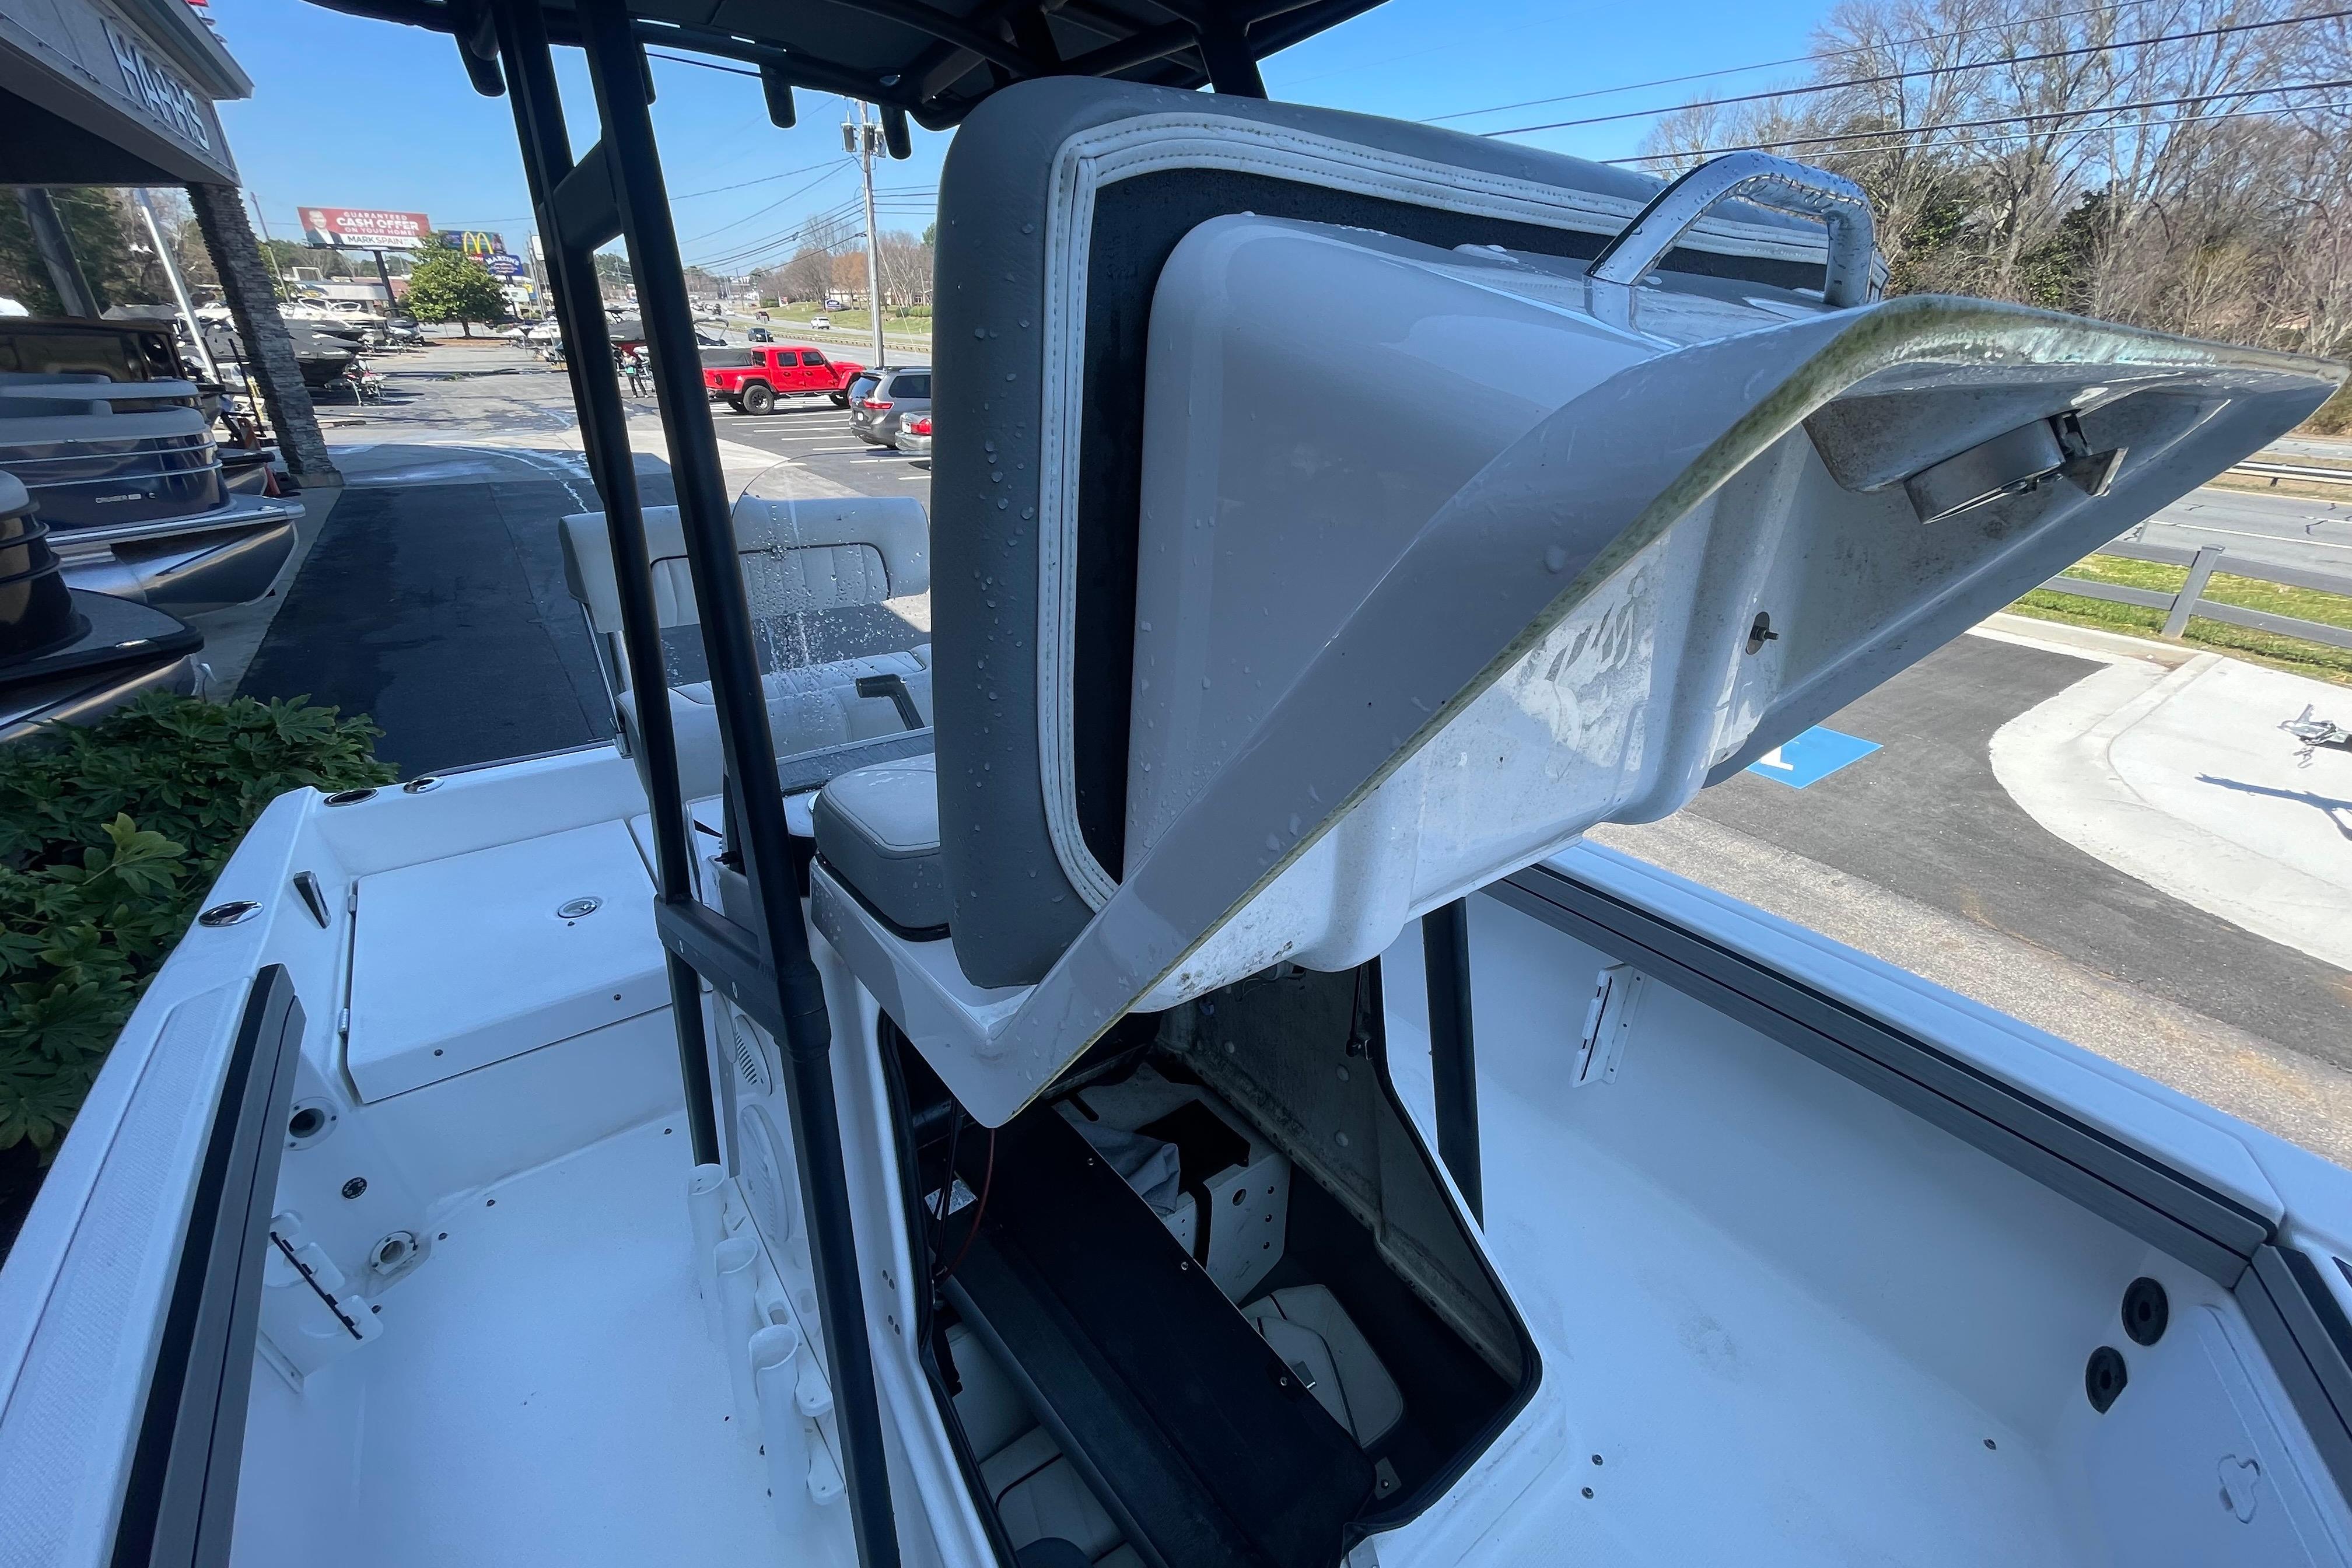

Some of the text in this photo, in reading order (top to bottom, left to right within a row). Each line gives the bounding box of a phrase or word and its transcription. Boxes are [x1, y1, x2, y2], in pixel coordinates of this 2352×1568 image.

[344, 211, 407, 220] GUARANTEED
[336, 217, 419, 231] CASH OFFER
[485, 255, 520, 266] MARTIN'S
